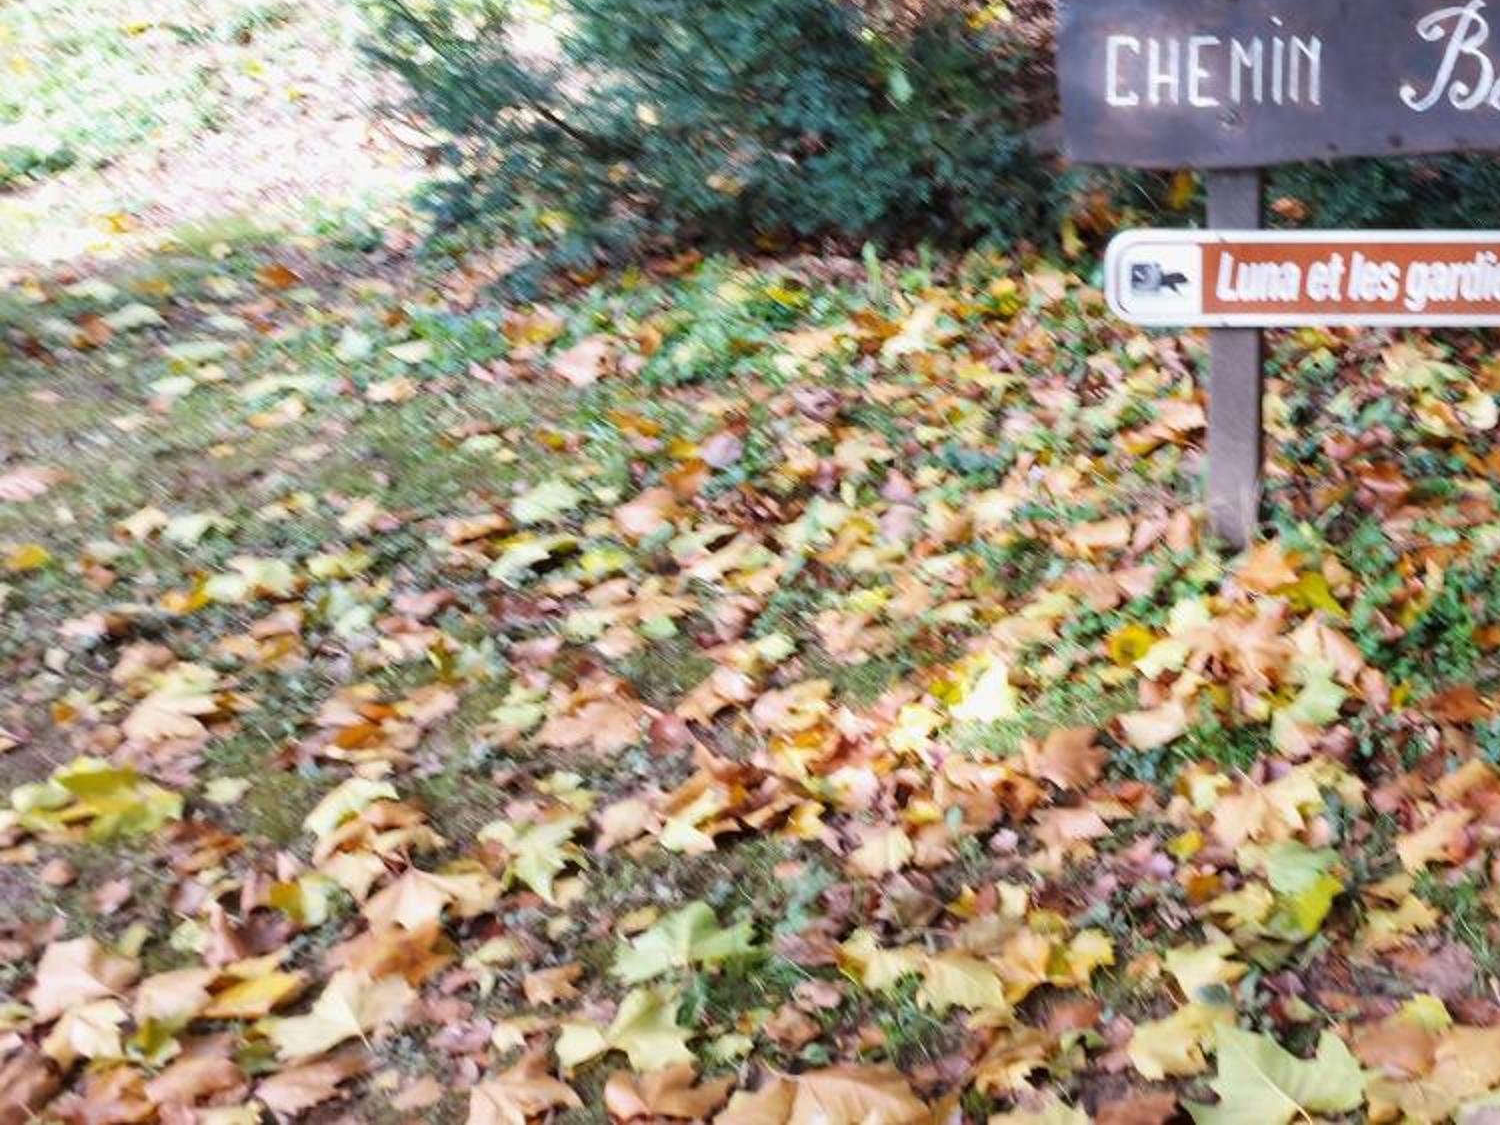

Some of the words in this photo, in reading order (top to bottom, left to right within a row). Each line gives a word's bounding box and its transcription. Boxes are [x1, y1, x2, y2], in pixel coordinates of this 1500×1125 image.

[1215, 250, 1302, 303] Luna
[1306, 251, 1345, 302] et
[1347, 250, 1400, 302] les
